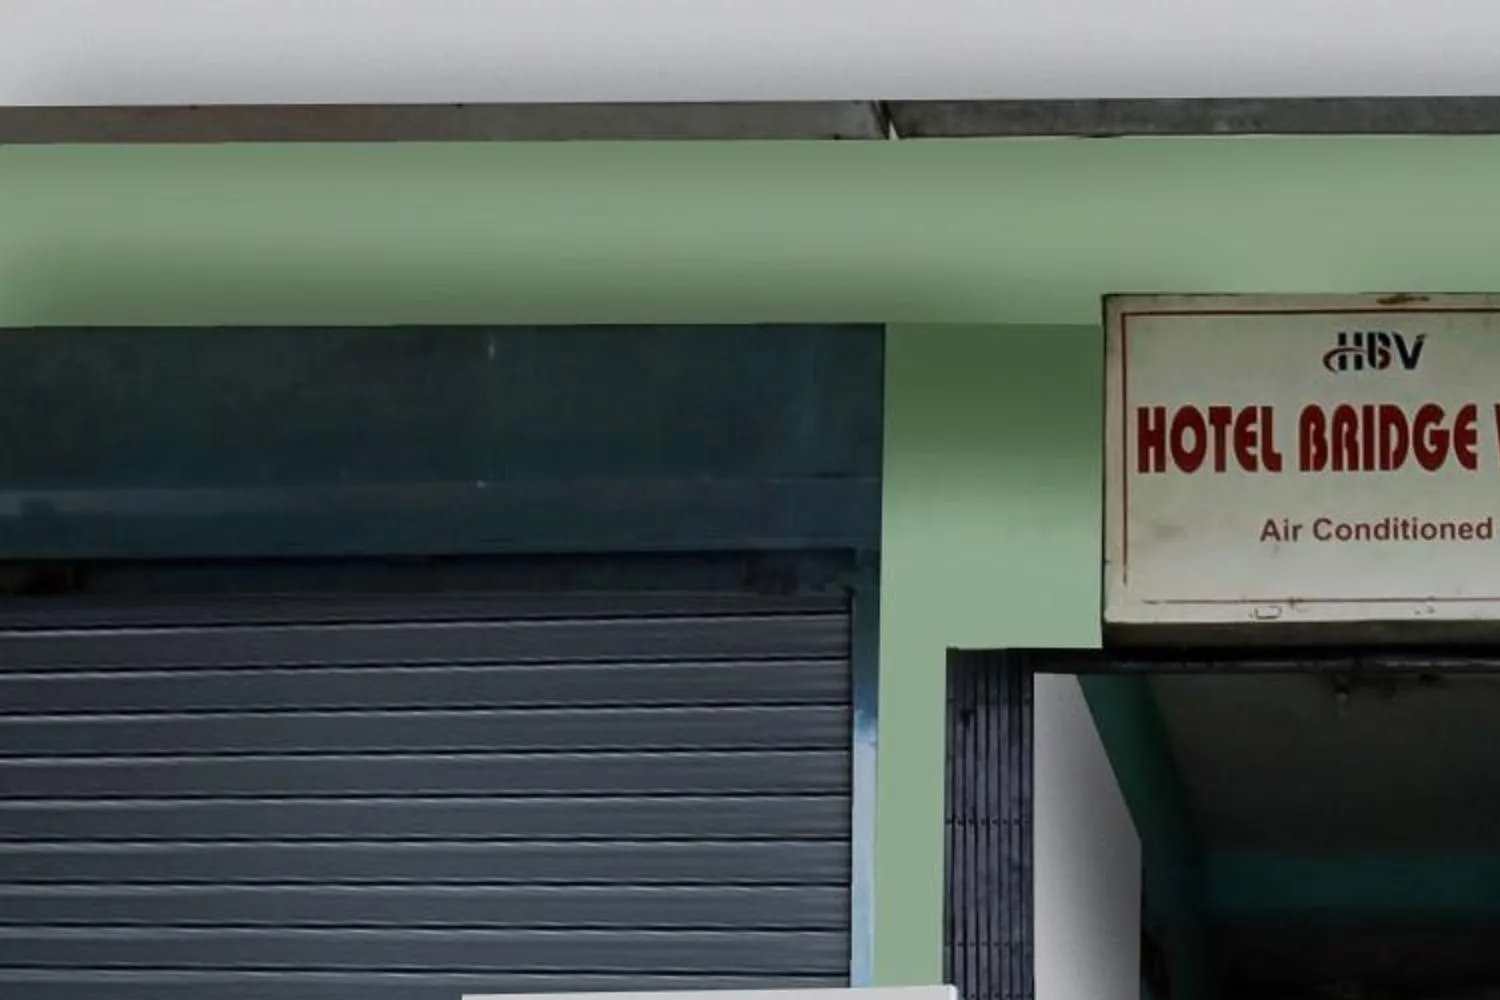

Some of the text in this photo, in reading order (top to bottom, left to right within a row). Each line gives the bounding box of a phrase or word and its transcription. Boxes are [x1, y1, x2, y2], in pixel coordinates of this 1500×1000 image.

[1322, 330, 1428, 374] HBV
[1136, 405, 1283, 474] HOTEL
[1299, 403, 1478, 473] BRIDGE
[1259, 516, 1494, 543] Air Conditioned
